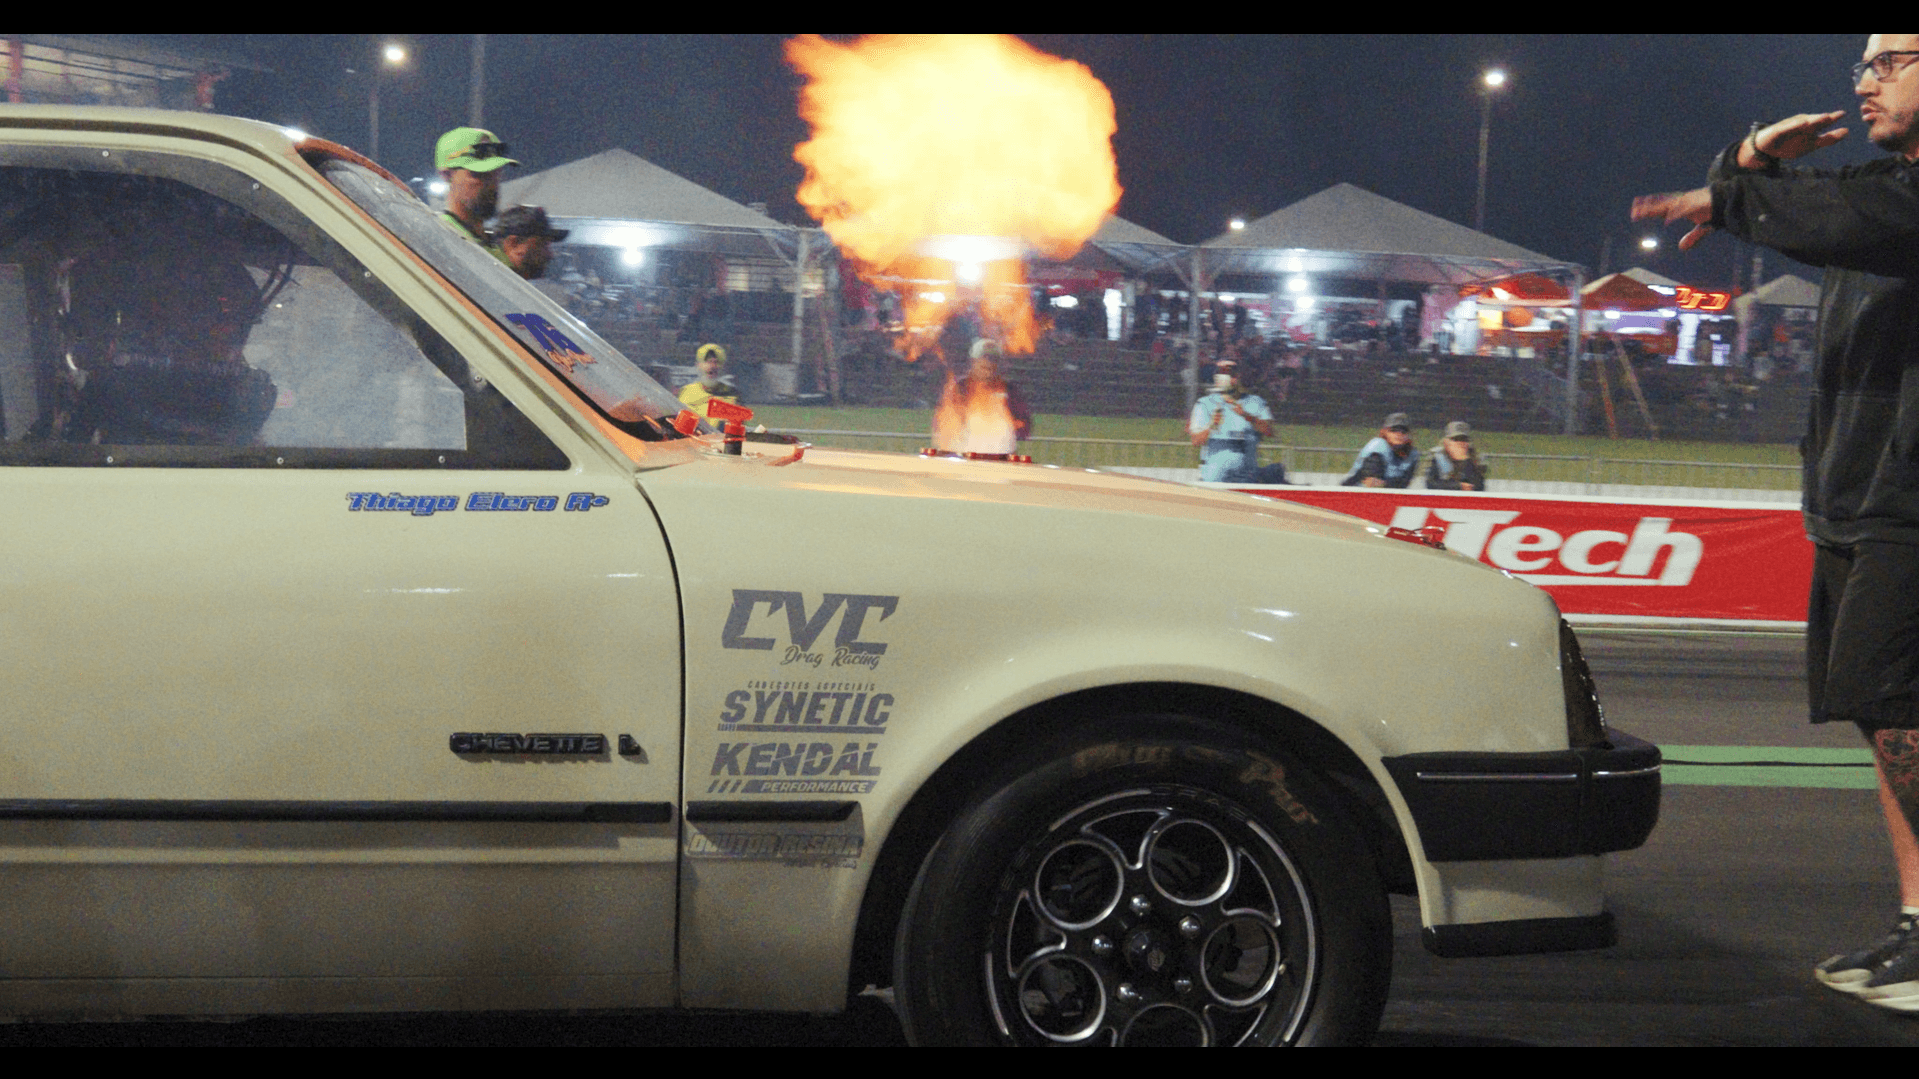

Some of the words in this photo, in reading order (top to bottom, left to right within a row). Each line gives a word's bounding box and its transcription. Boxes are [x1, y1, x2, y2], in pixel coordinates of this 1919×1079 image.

[347, 492, 460, 516] Thiago
[464, 492, 559, 511] Elero
[721, 589, 900, 655] CVC
[780, 645, 823, 668] Drag
[831, 647, 881, 671] Racing
[719, 690, 895, 727] SYNETIC
[450, 732, 604, 754] CHEVETTE
[710, 743, 882, 776] KENDAL
[760, 781, 869, 793] PERFORMANCE
